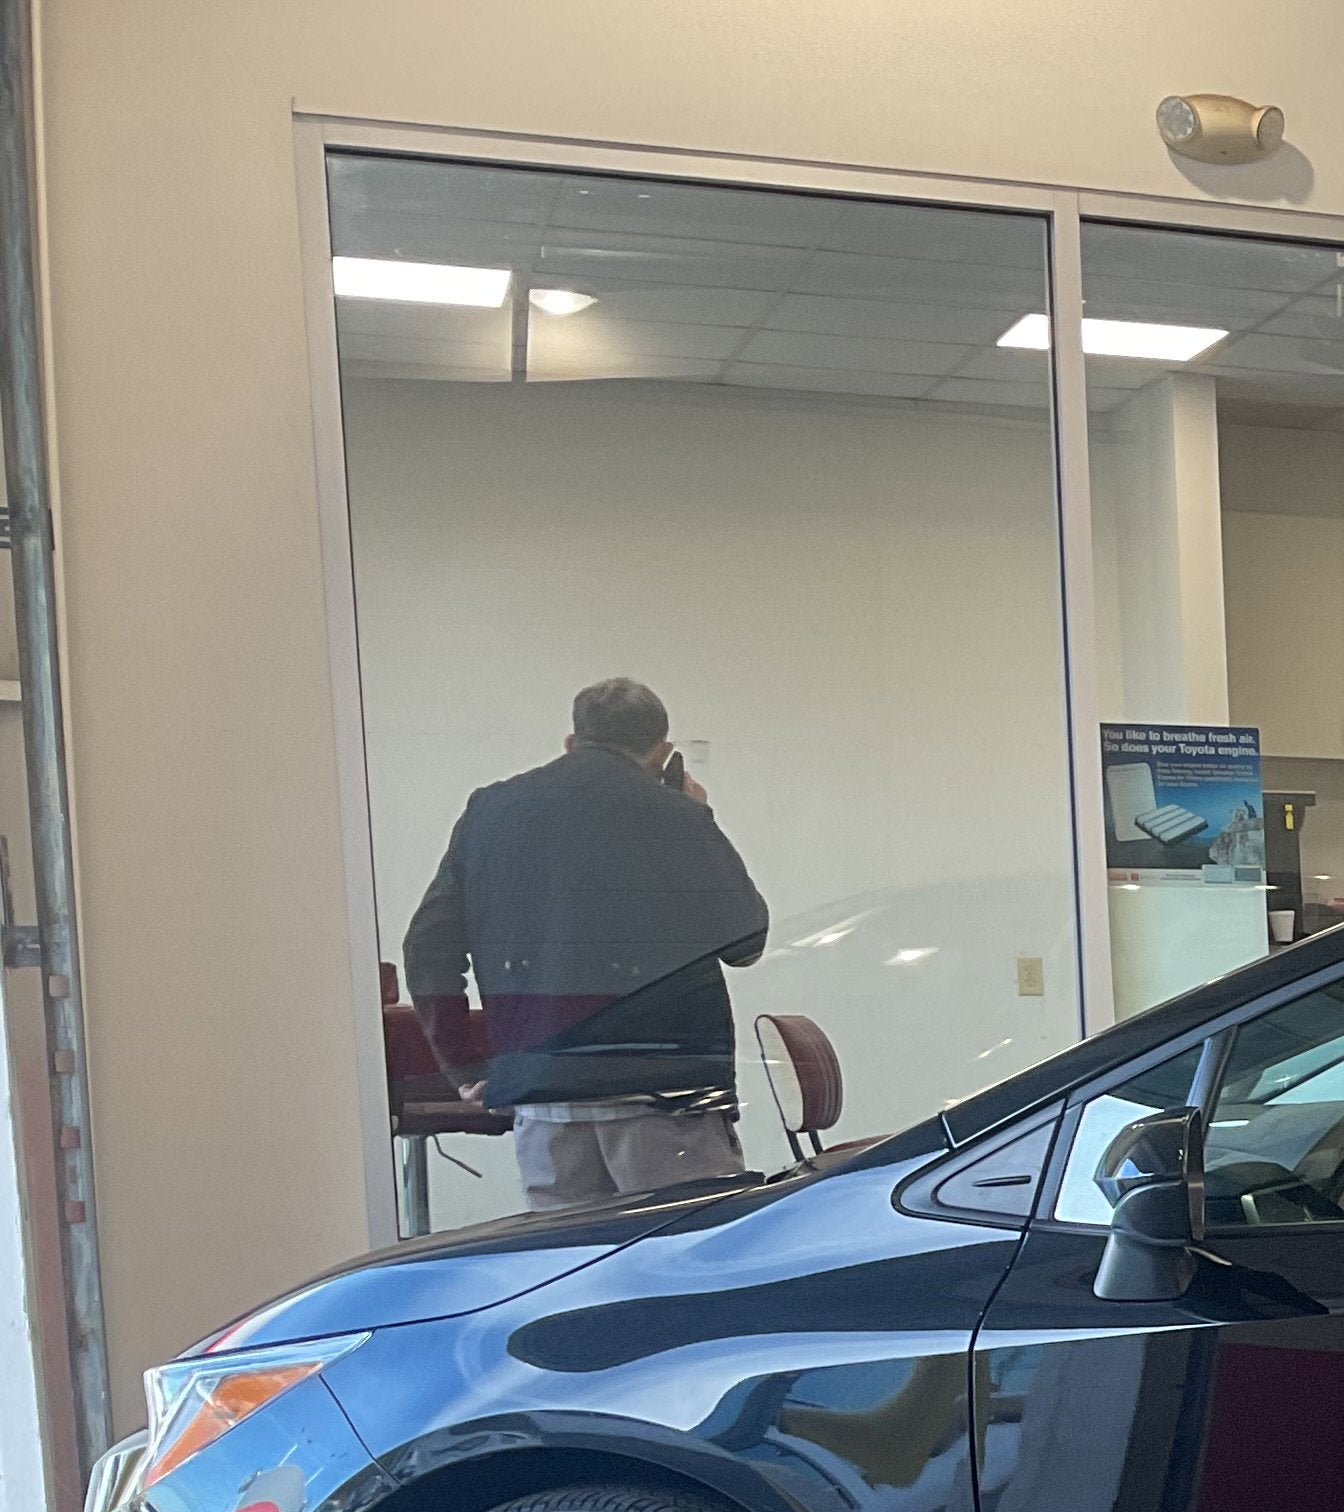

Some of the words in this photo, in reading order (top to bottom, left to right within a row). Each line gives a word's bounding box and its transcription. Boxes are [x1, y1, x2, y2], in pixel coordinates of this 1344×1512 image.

[1103, 729, 1124, 740] You
[1125, 730, 1147, 740] like
[1148, 730, 1161, 741] to
[1162, 731, 1207, 742] breathe
[1208, 732, 1237, 743] fresh
[1103, 740, 1120, 752] So
[1121, 742, 1150, 753] does
[1151, 744, 1177, 755] your
[1178, 743, 1216, 757] Toyota
